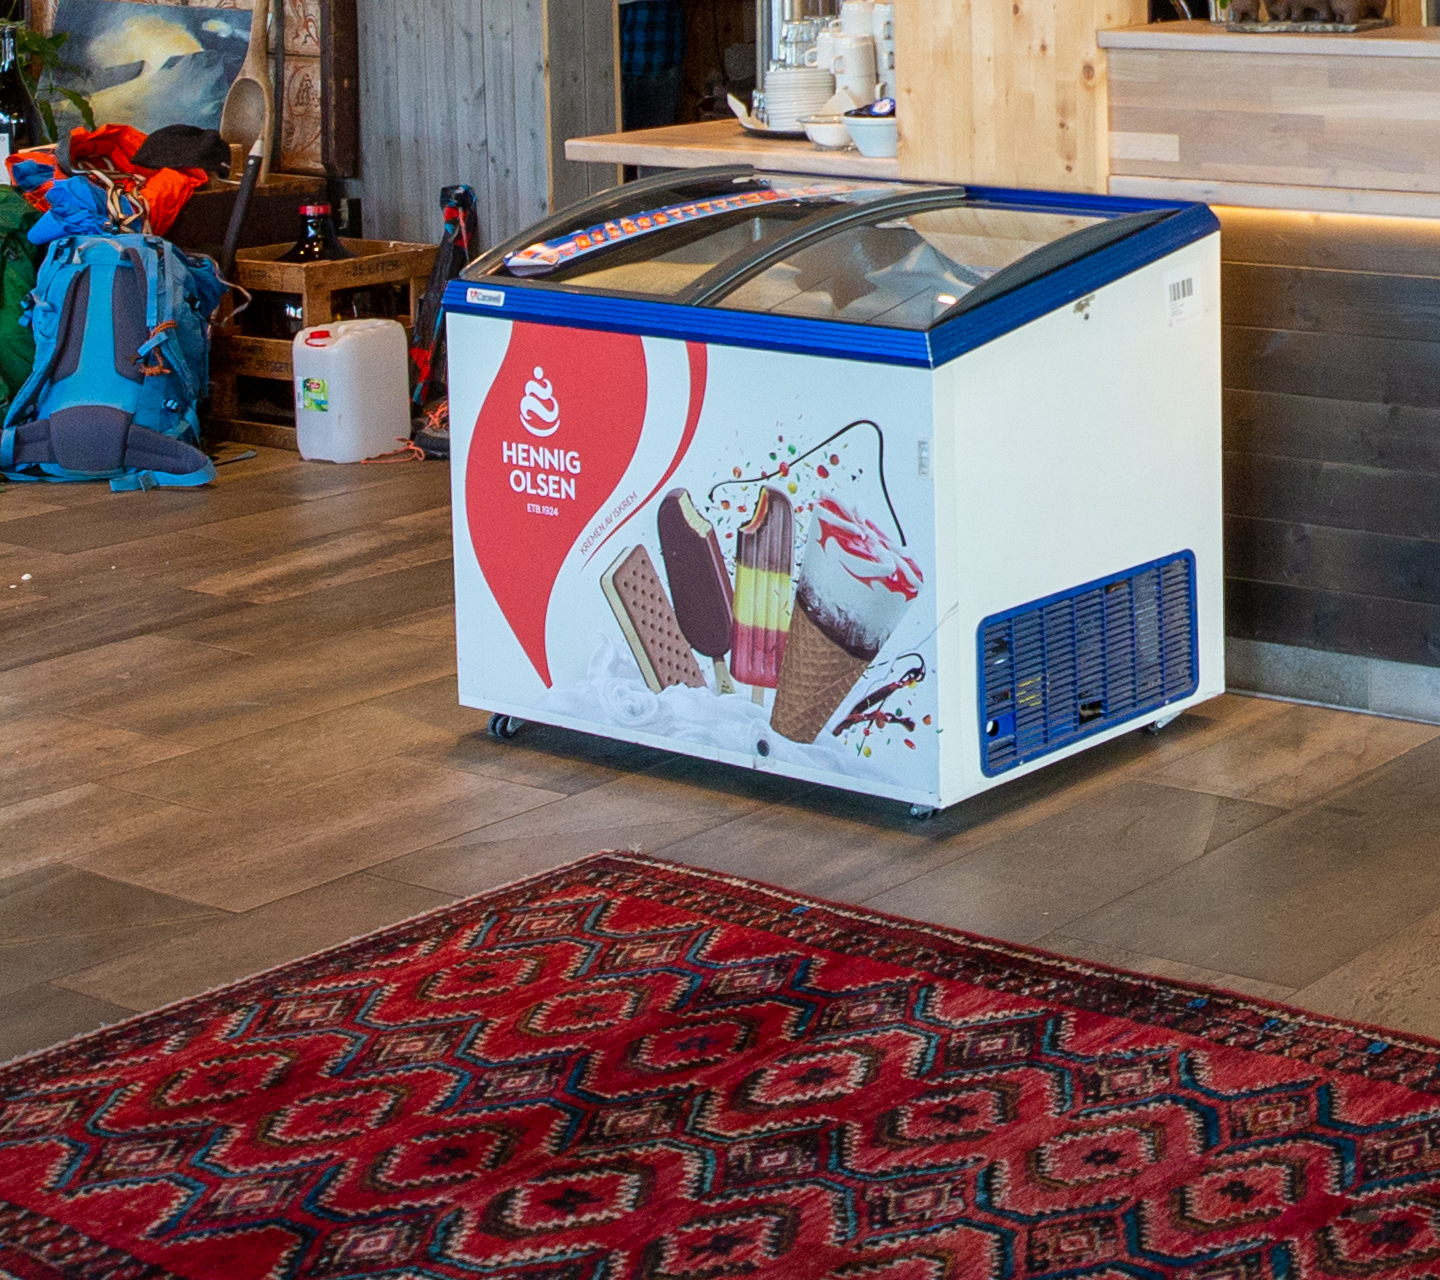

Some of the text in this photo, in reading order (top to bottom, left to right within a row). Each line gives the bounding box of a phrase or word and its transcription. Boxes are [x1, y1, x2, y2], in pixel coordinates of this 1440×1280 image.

[501, 440, 582, 474] HENNIG
[509, 469, 577, 501] OLSEN
[526, 502, 559, 517] ETB.1924
[579, 522, 607, 555] KREMEN
[611, 491, 639, 520] ISKREM
